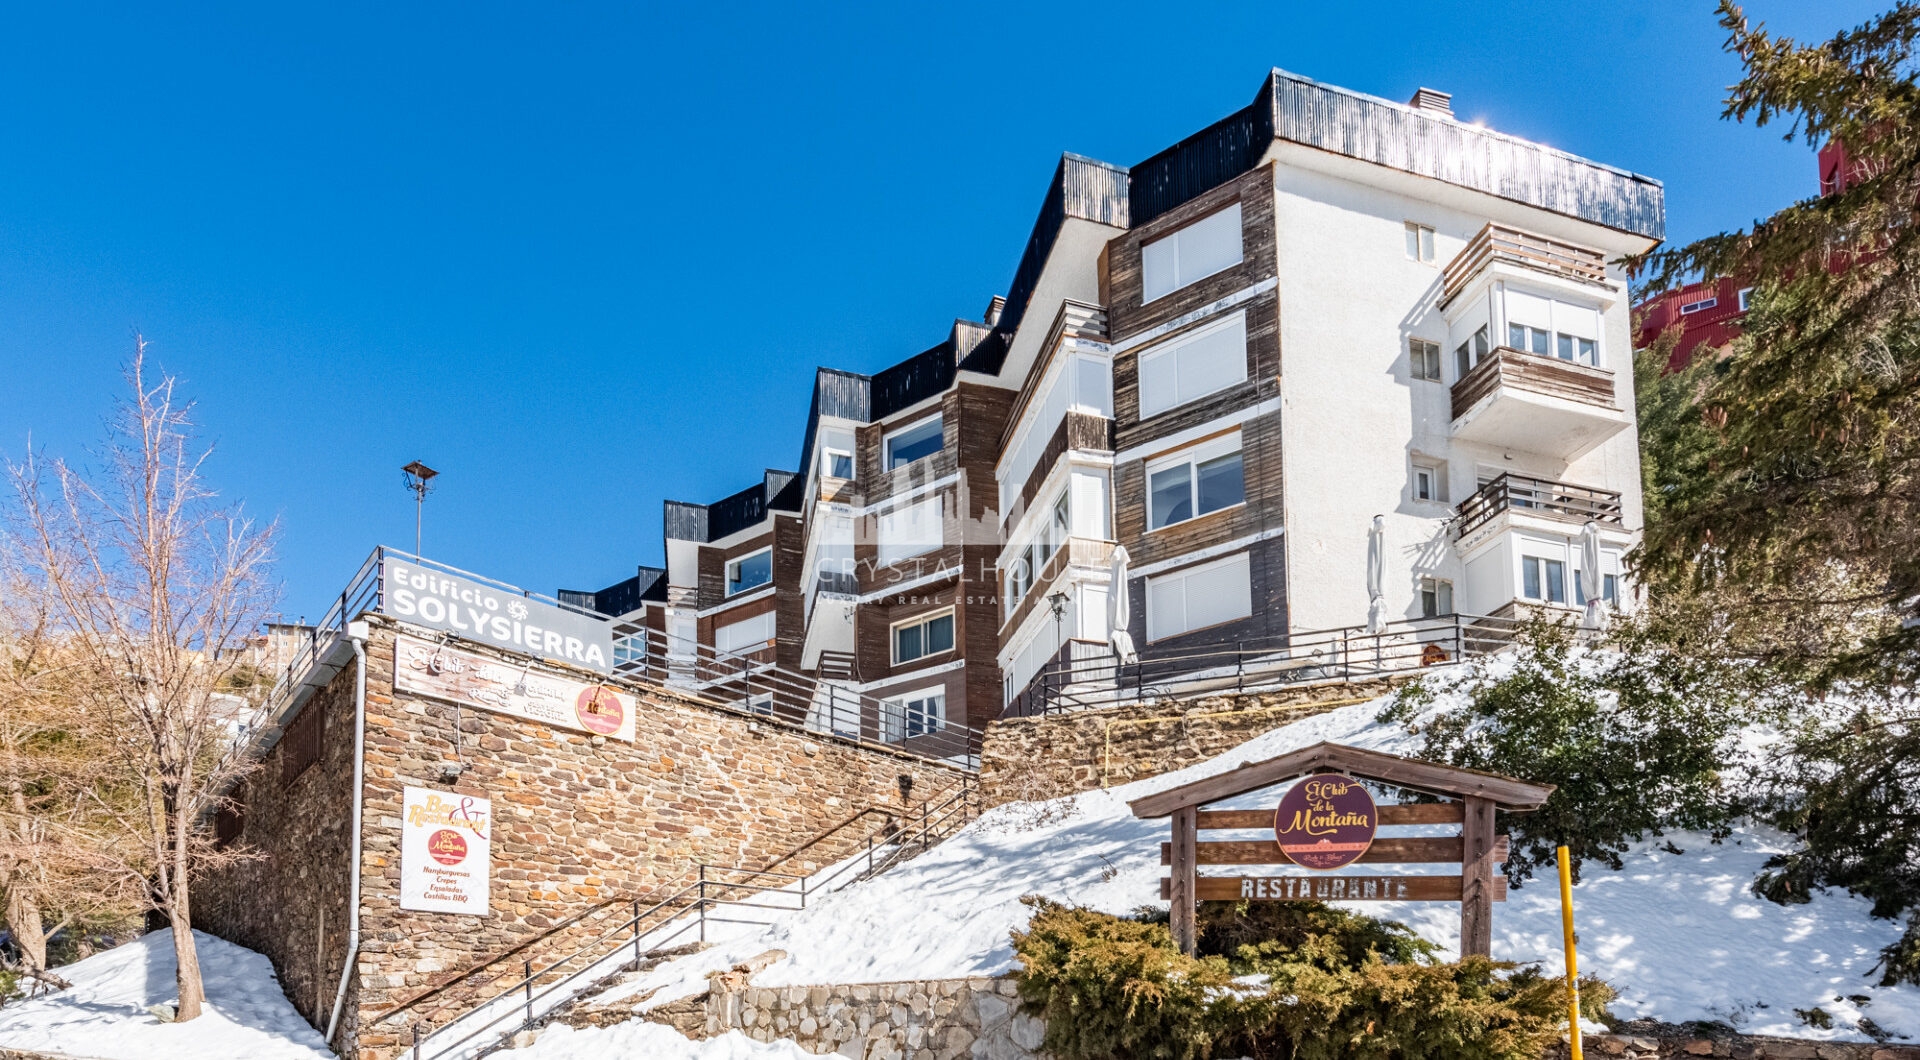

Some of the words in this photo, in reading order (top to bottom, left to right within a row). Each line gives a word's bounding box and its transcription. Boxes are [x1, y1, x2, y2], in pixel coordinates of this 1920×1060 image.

[393, 567, 499, 611] Edificio
[393, 588, 607, 668] SOLYSIERRA
[1305, 781, 1320, 801] El
[1321, 782, 1361, 800] Club
[426, 794, 456, 814] Bar
[1309, 800, 1324, 812] de
[1325, 801, 1335, 811] la
[1280, 809, 1369, 836] Montaña
[423, 866, 470, 877] Hamburguesas
[436, 876, 457, 884] Crepes
[423, 892, 451, 901] Costillas
[452, 894, 468, 903] BBQ
[430, 884, 463, 893] Ensaladas
[1241, 878, 1408, 899] RESTAURANTE
